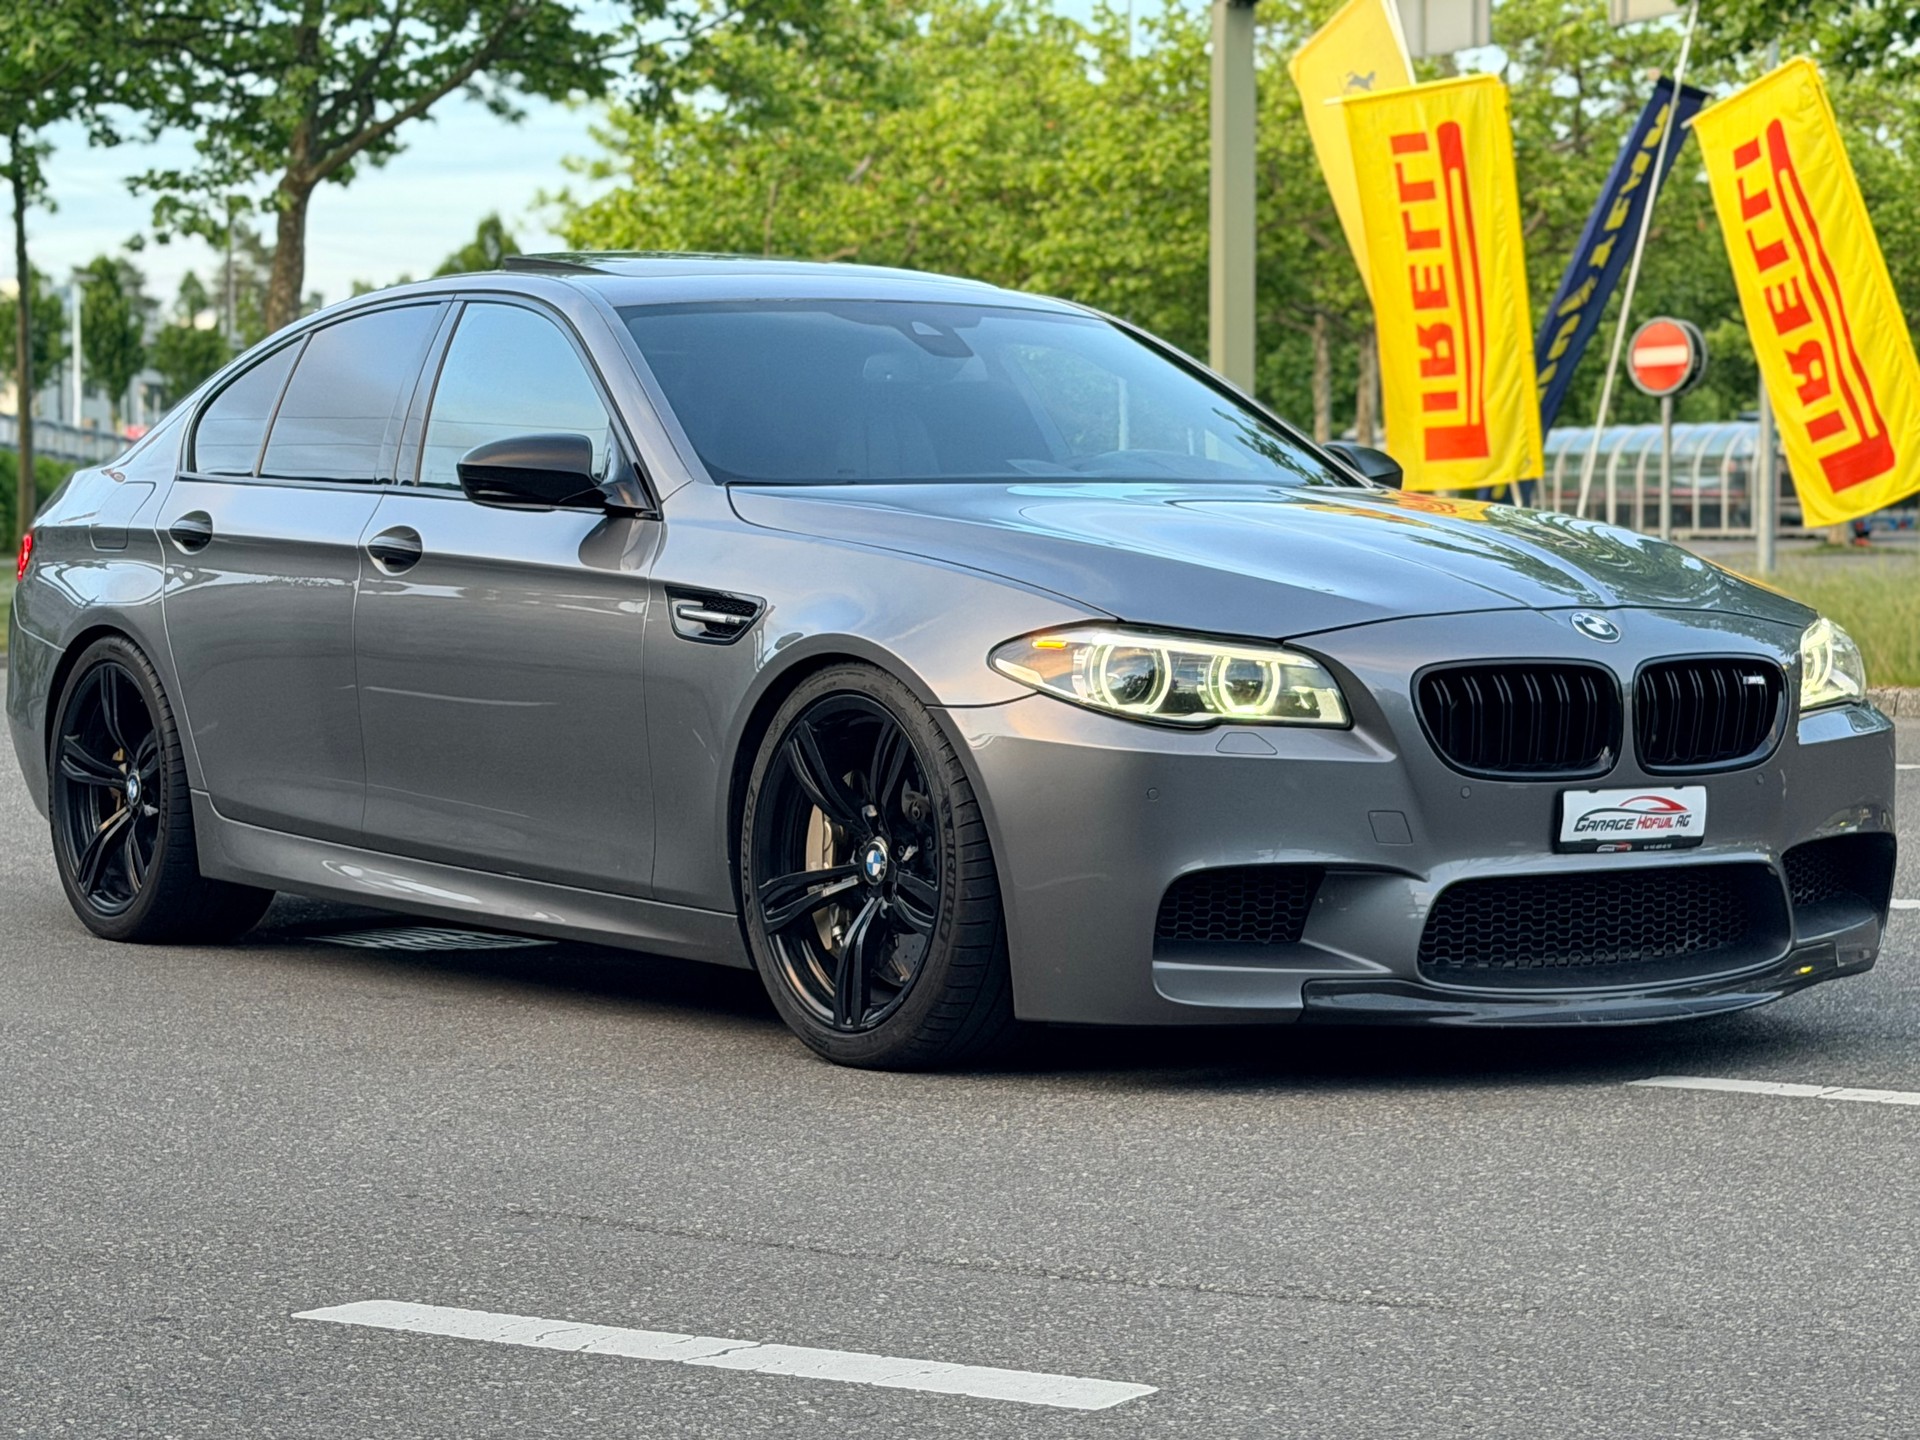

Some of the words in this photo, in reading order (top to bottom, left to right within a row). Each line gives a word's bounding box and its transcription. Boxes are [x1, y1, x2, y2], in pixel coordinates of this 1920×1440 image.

[1573, 817, 1636, 832] GARAGE
[1636, 815, 1673, 830] HOFWIL
[1674, 815, 1692, 828] AG
[941, 827, 956, 940] MICHELIN
